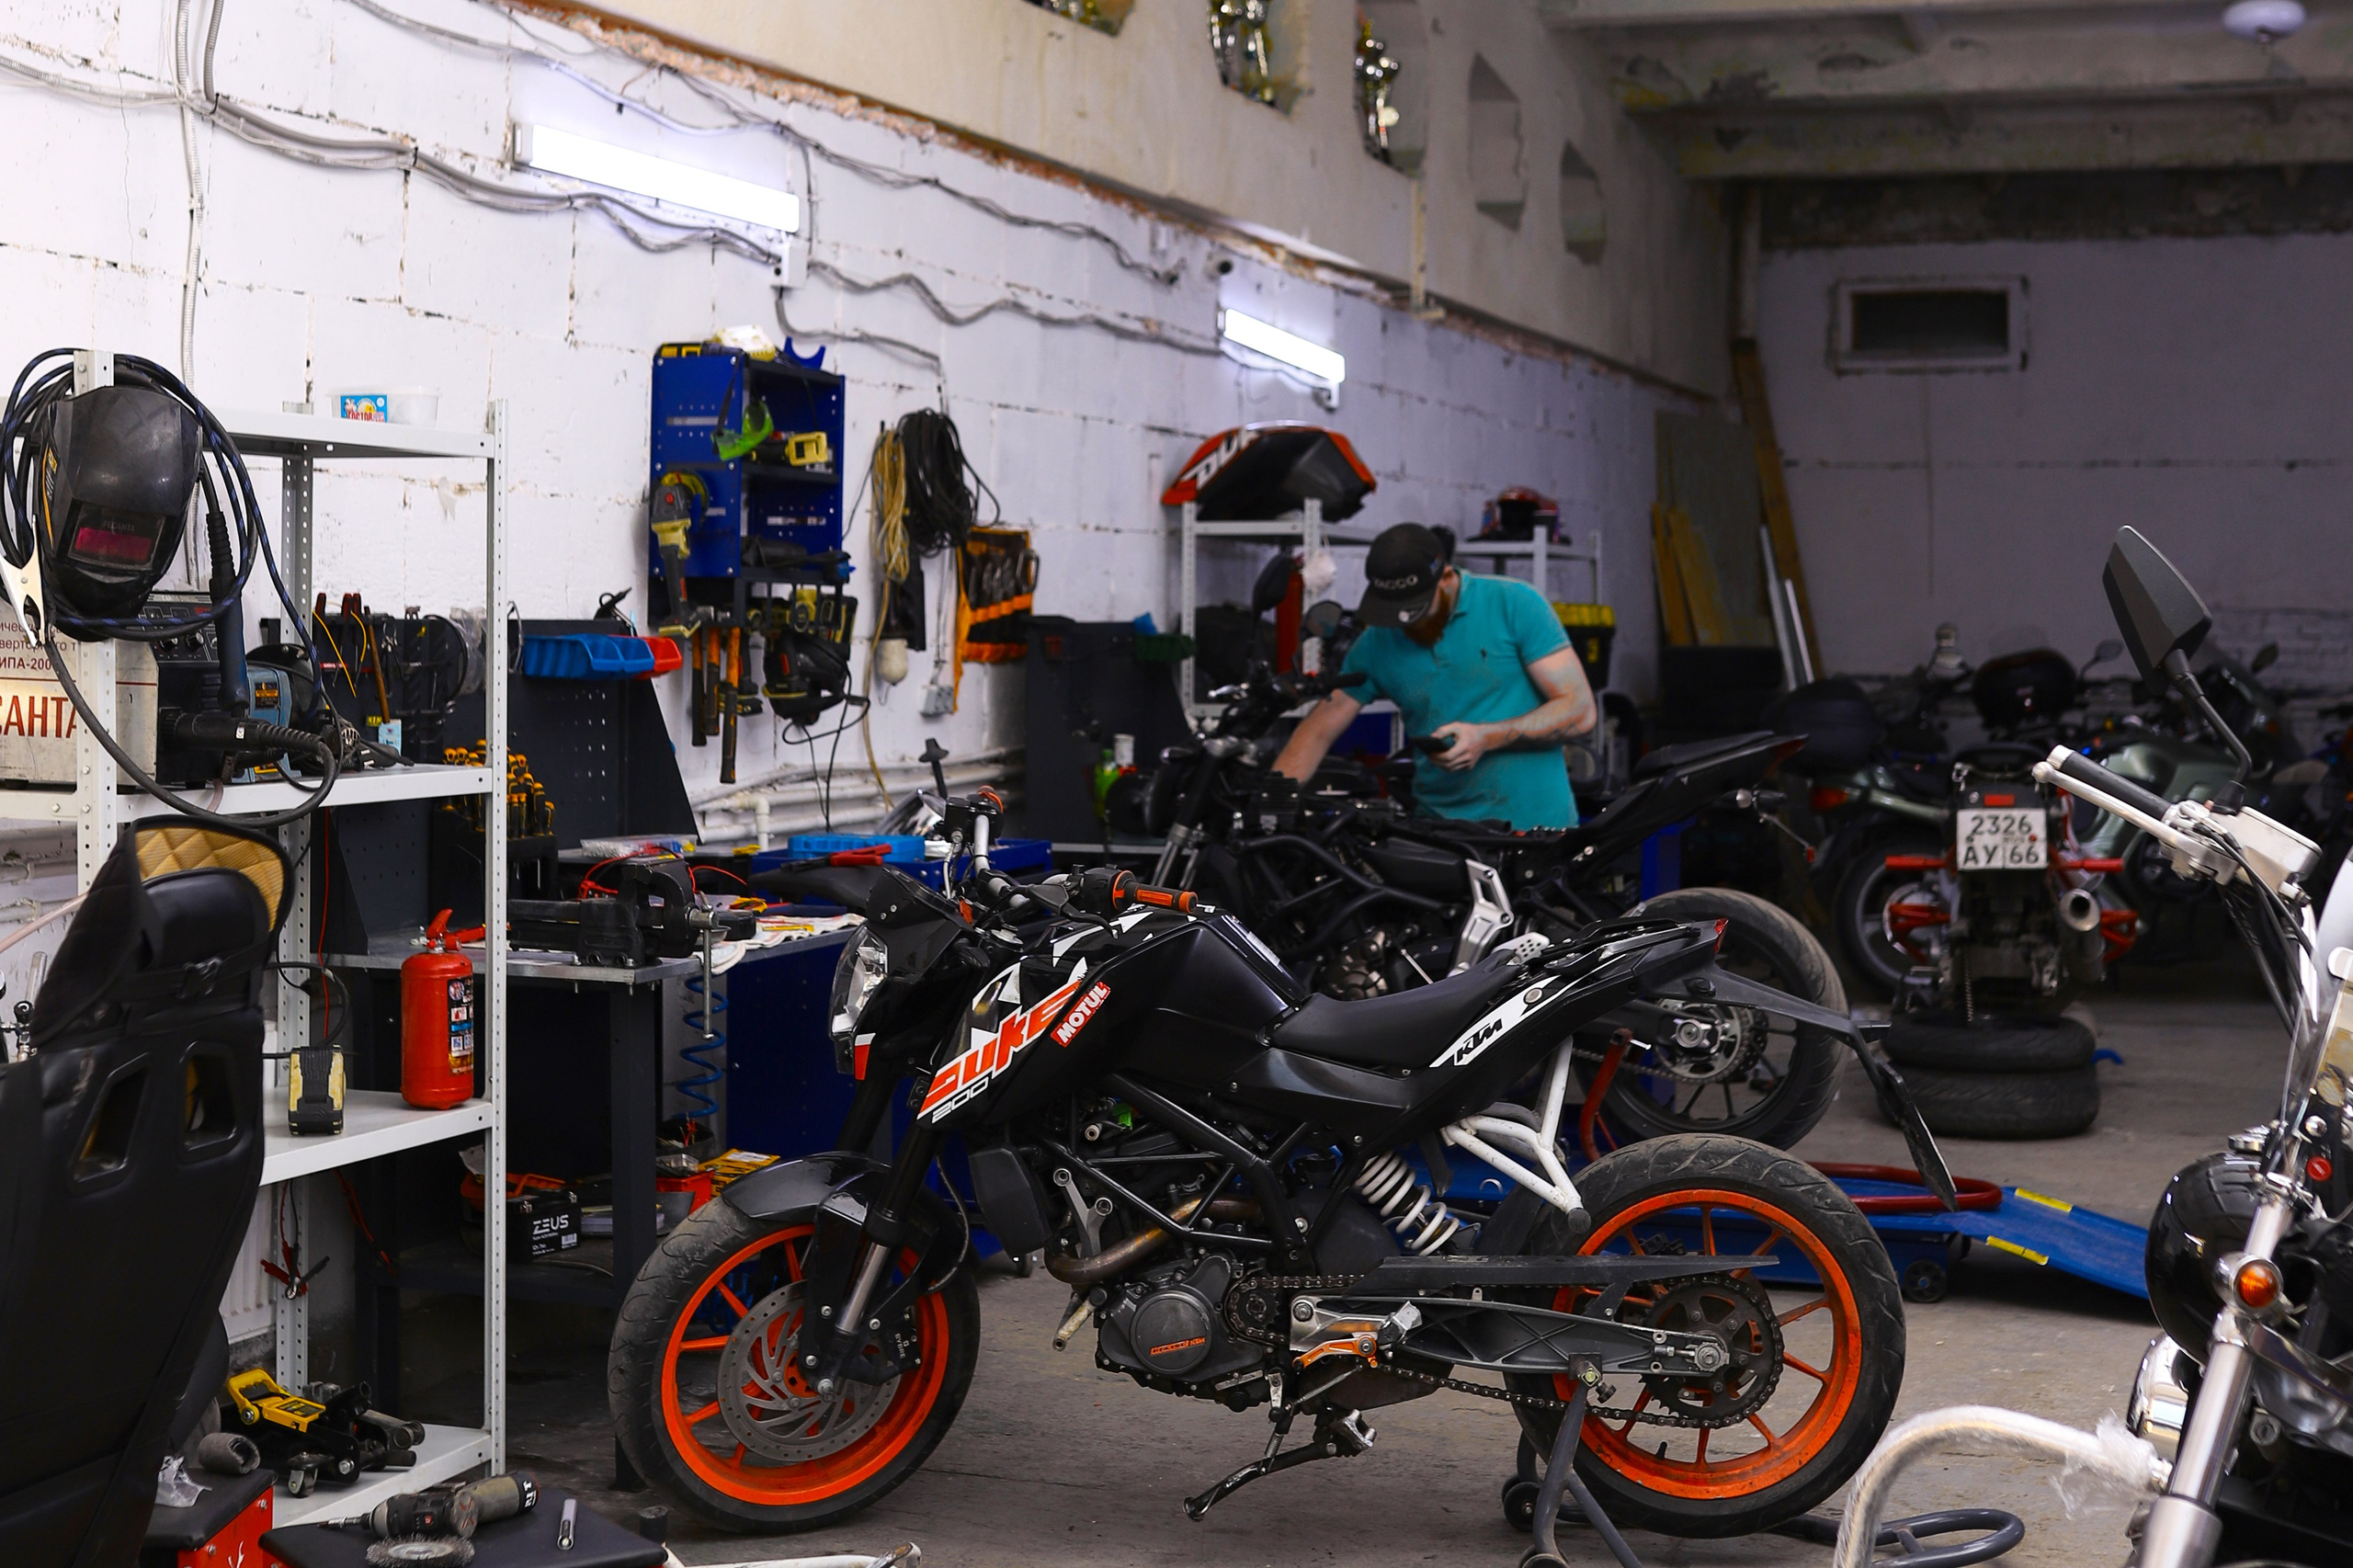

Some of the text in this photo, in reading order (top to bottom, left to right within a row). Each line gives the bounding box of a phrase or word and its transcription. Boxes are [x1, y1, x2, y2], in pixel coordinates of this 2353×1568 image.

[0, 695, 77, 738] АНТ
[1971, 814, 2032, 835] 2326
[2009, 846, 2040, 865] 66
[1056, 984, 1108, 1044] MOTUL
[1456, 1017, 1503, 1063] KTM
[931, 1076, 989, 1124] 200
[532, 1214, 570, 1235] ZEUS
